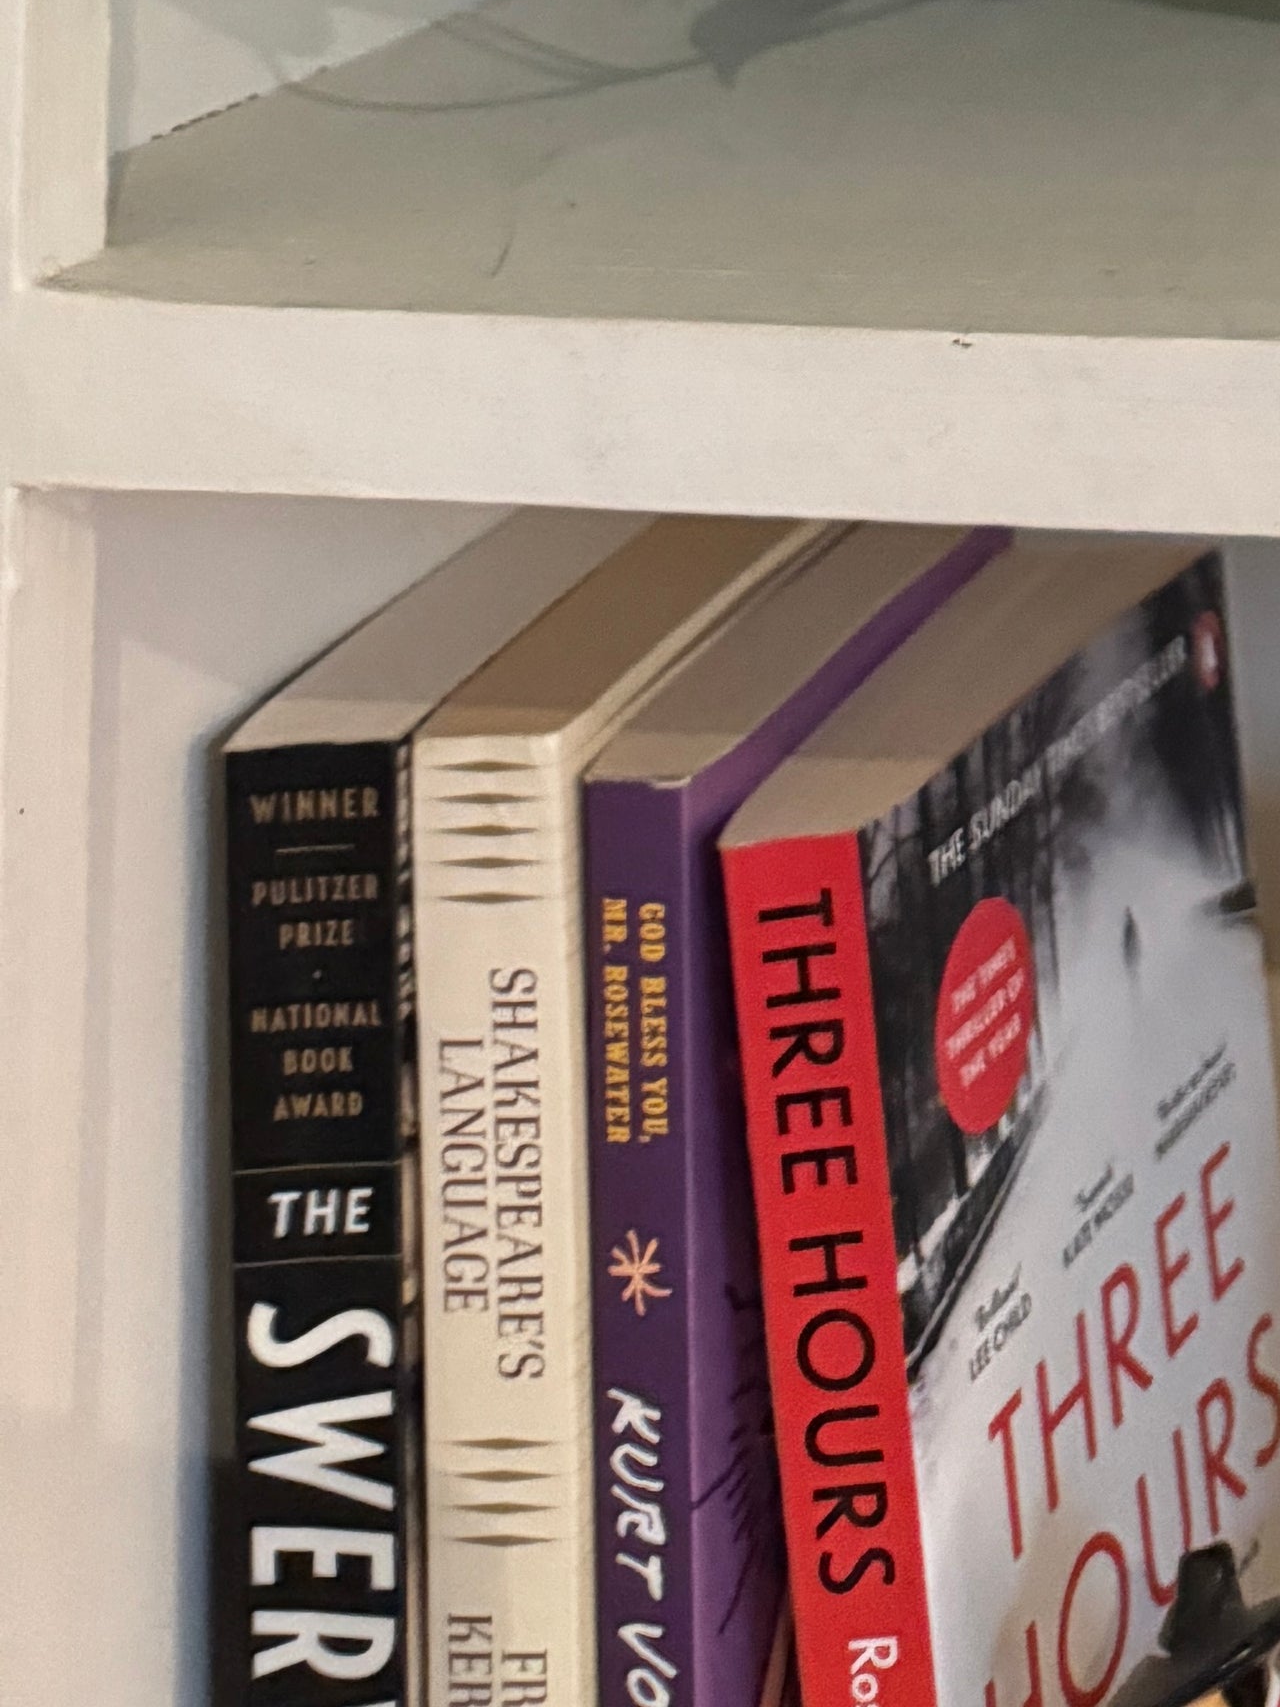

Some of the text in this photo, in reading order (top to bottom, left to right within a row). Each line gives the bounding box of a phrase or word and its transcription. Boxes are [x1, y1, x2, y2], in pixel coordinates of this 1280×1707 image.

[250, 788, 381, 824] WINNER
[251, 872, 379, 907] PULITZER
[278, 918, 355, 951] PRIZE
[250, 1000, 383, 1034] NATIONAL
[601, 897, 632, 1144] MR. ROSEWATER
[637, 901, 670, 1144] GOD BLESS YOU,
[282, 1046, 354, 1076] BOOK
[273, 1090, 363, 1123] AWARD
[267, 1186, 375, 1239] THE
[437, 1037, 490, 1315] LANGUAGE
[487, 966, 547, 1382] SHAKESPEARE'S
[758, 885, 898, 1596] THREE HOURS
[986, 1139, 1246, 1563] THREE
[247, 1300, 397, 1707] SWER
[607, 1386, 678, 1707] KURT VO
[447, 1612, 493, 1707] KER
[501, 1648, 548, 1707] FR
[848, 1635, 899, 1707] Ro
